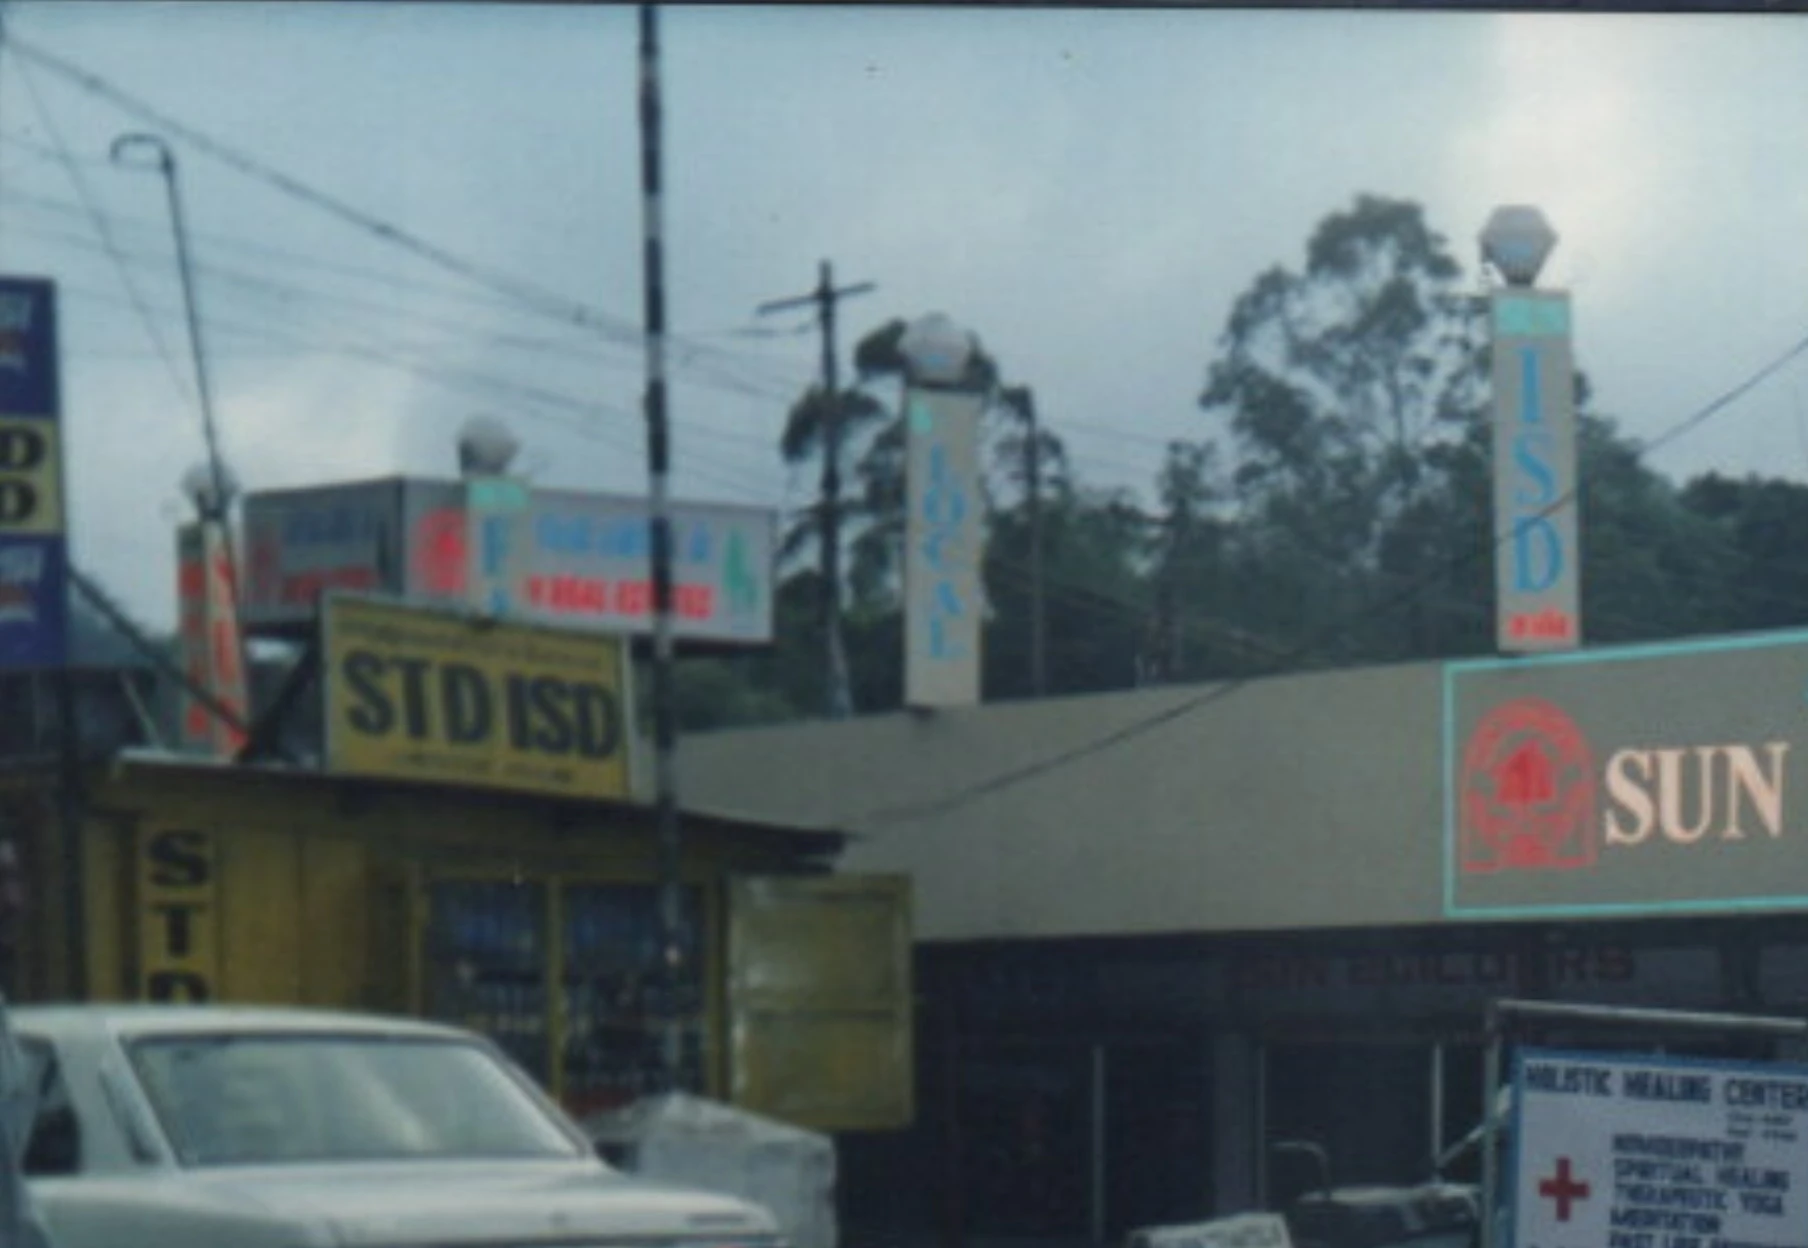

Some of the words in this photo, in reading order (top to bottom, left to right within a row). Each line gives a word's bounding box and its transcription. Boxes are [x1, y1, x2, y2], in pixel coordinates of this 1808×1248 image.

[1512, 346, 1563, 592] ISD
[344, 649, 491, 746] STD
[506, 671, 619, 760] ISD
[1604, 741, 1790, 846] SUN
[1525, 1064, 1611, 1097] HOLISTIC
[1622, 1070, 1711, 1104] HEALING
[1717, 1166, 1791, 1192] HEALING
[1740, 1192, 1784, 1215] YOGA
